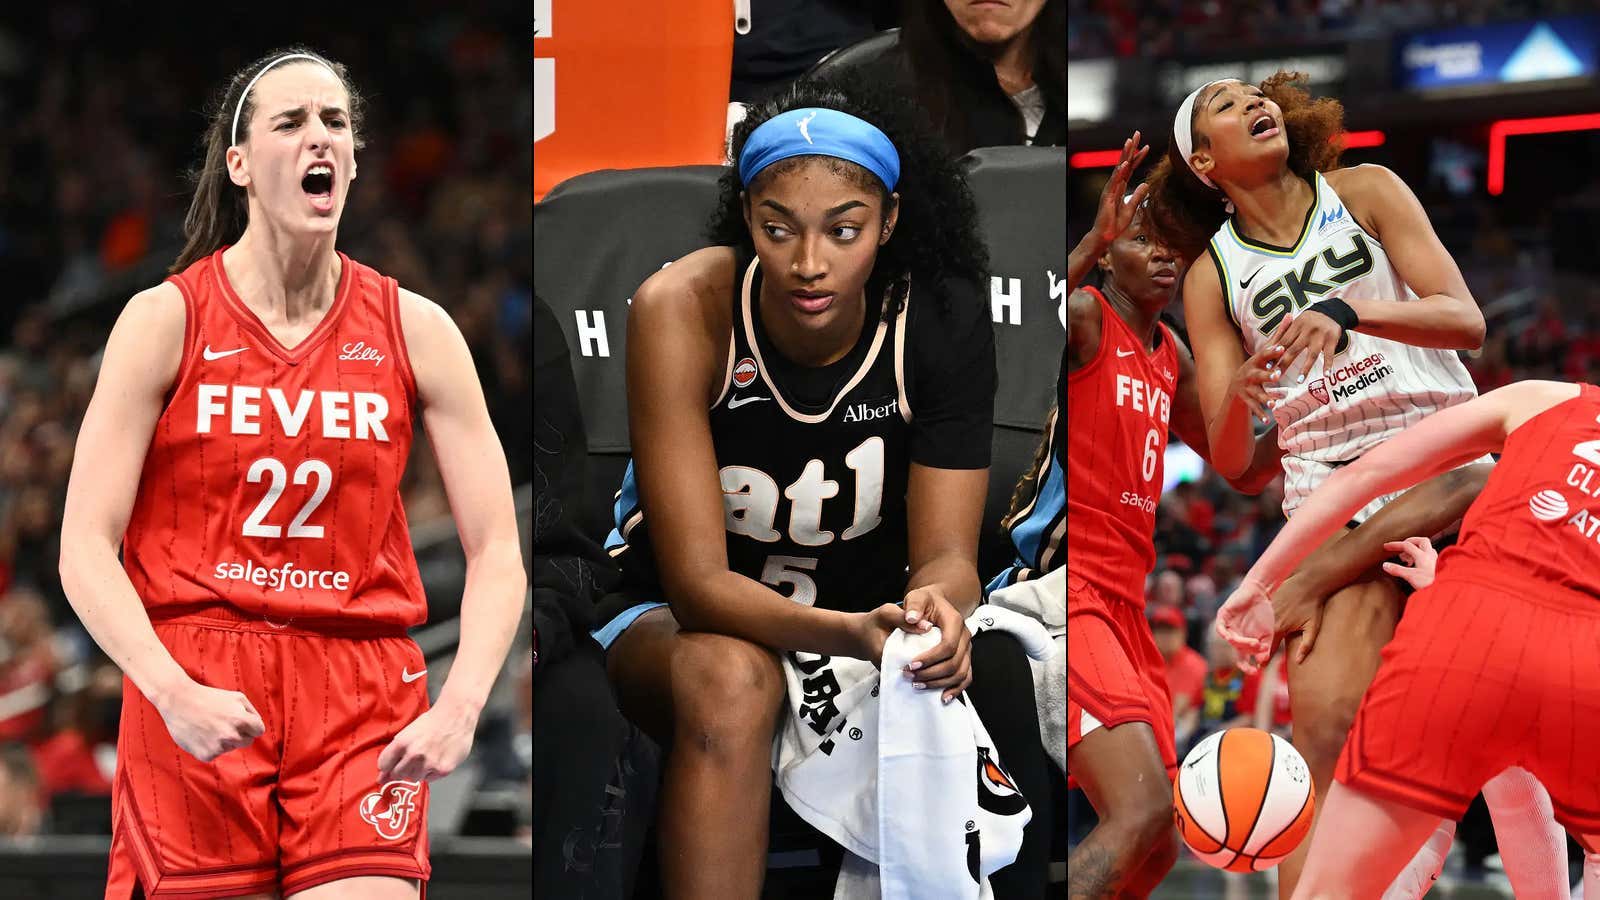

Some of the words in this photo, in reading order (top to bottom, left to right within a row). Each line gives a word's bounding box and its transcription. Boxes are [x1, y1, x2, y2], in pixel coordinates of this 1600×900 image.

[991, 276, 1021, 325] H
[1251, 233, 1375, 338] SKY
[339, 341, 386, 366] Lilly
[575, 310, 610, 357] H
[1328, 352, 1386, 387] UChicago
[1332, 364, 1395, 403] Medicine
[196, 383, 391, 442] FEVER
[843, 398, 898, 423] Albert
[1142, 428, 1160, 482] 6
[242, 457, 332, 538] 22
[719, 435, 885, 547] atl
[1568, 508, 1600, 545] AT
[214, 559, 350, 592] salesforce
[760, 555, 820, 608] 5
